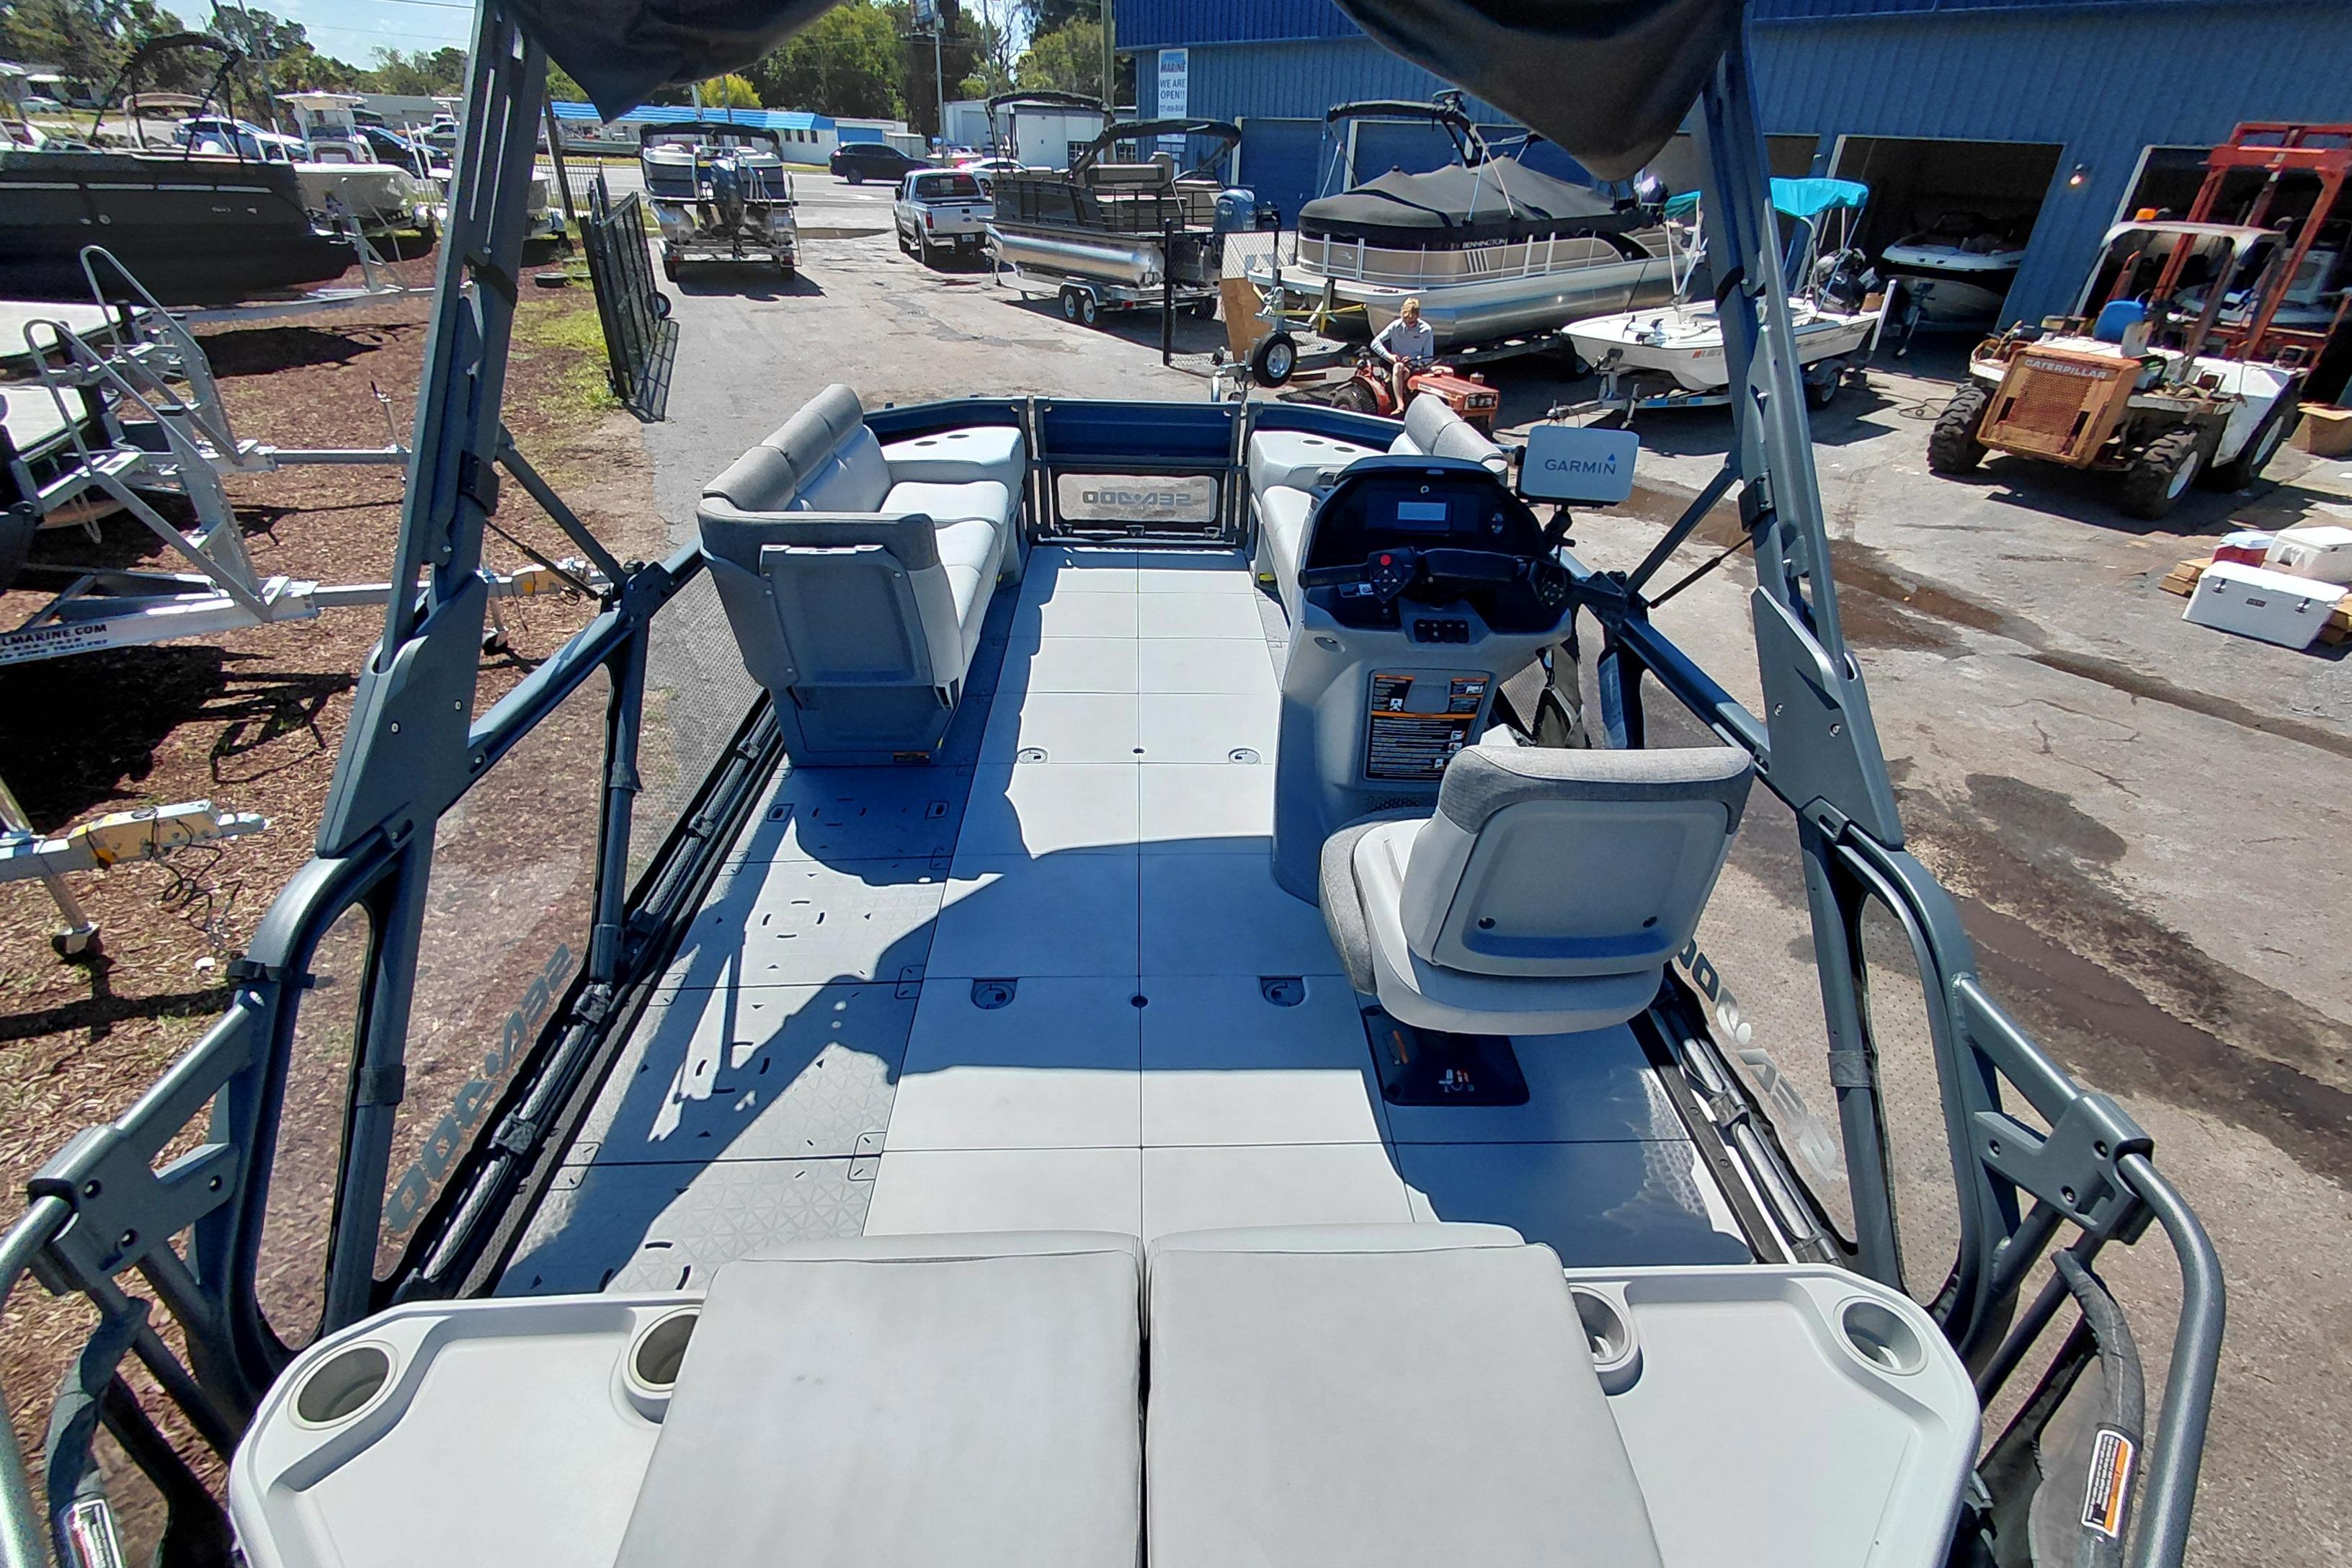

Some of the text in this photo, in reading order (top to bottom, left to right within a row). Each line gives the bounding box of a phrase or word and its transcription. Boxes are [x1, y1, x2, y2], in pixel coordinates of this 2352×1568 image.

[1161, 63, 1186, 73] MARINE
[1160, 79, 1186, 88] WE ARE
[1160, 90, 1185, 99] OPEN!!
[1462, 238, 1508, 249] BENNINGTON
[2024, 360, 2108, 379] CATERPILLAR
[1544, 459, 1616, 475] GARMIN
